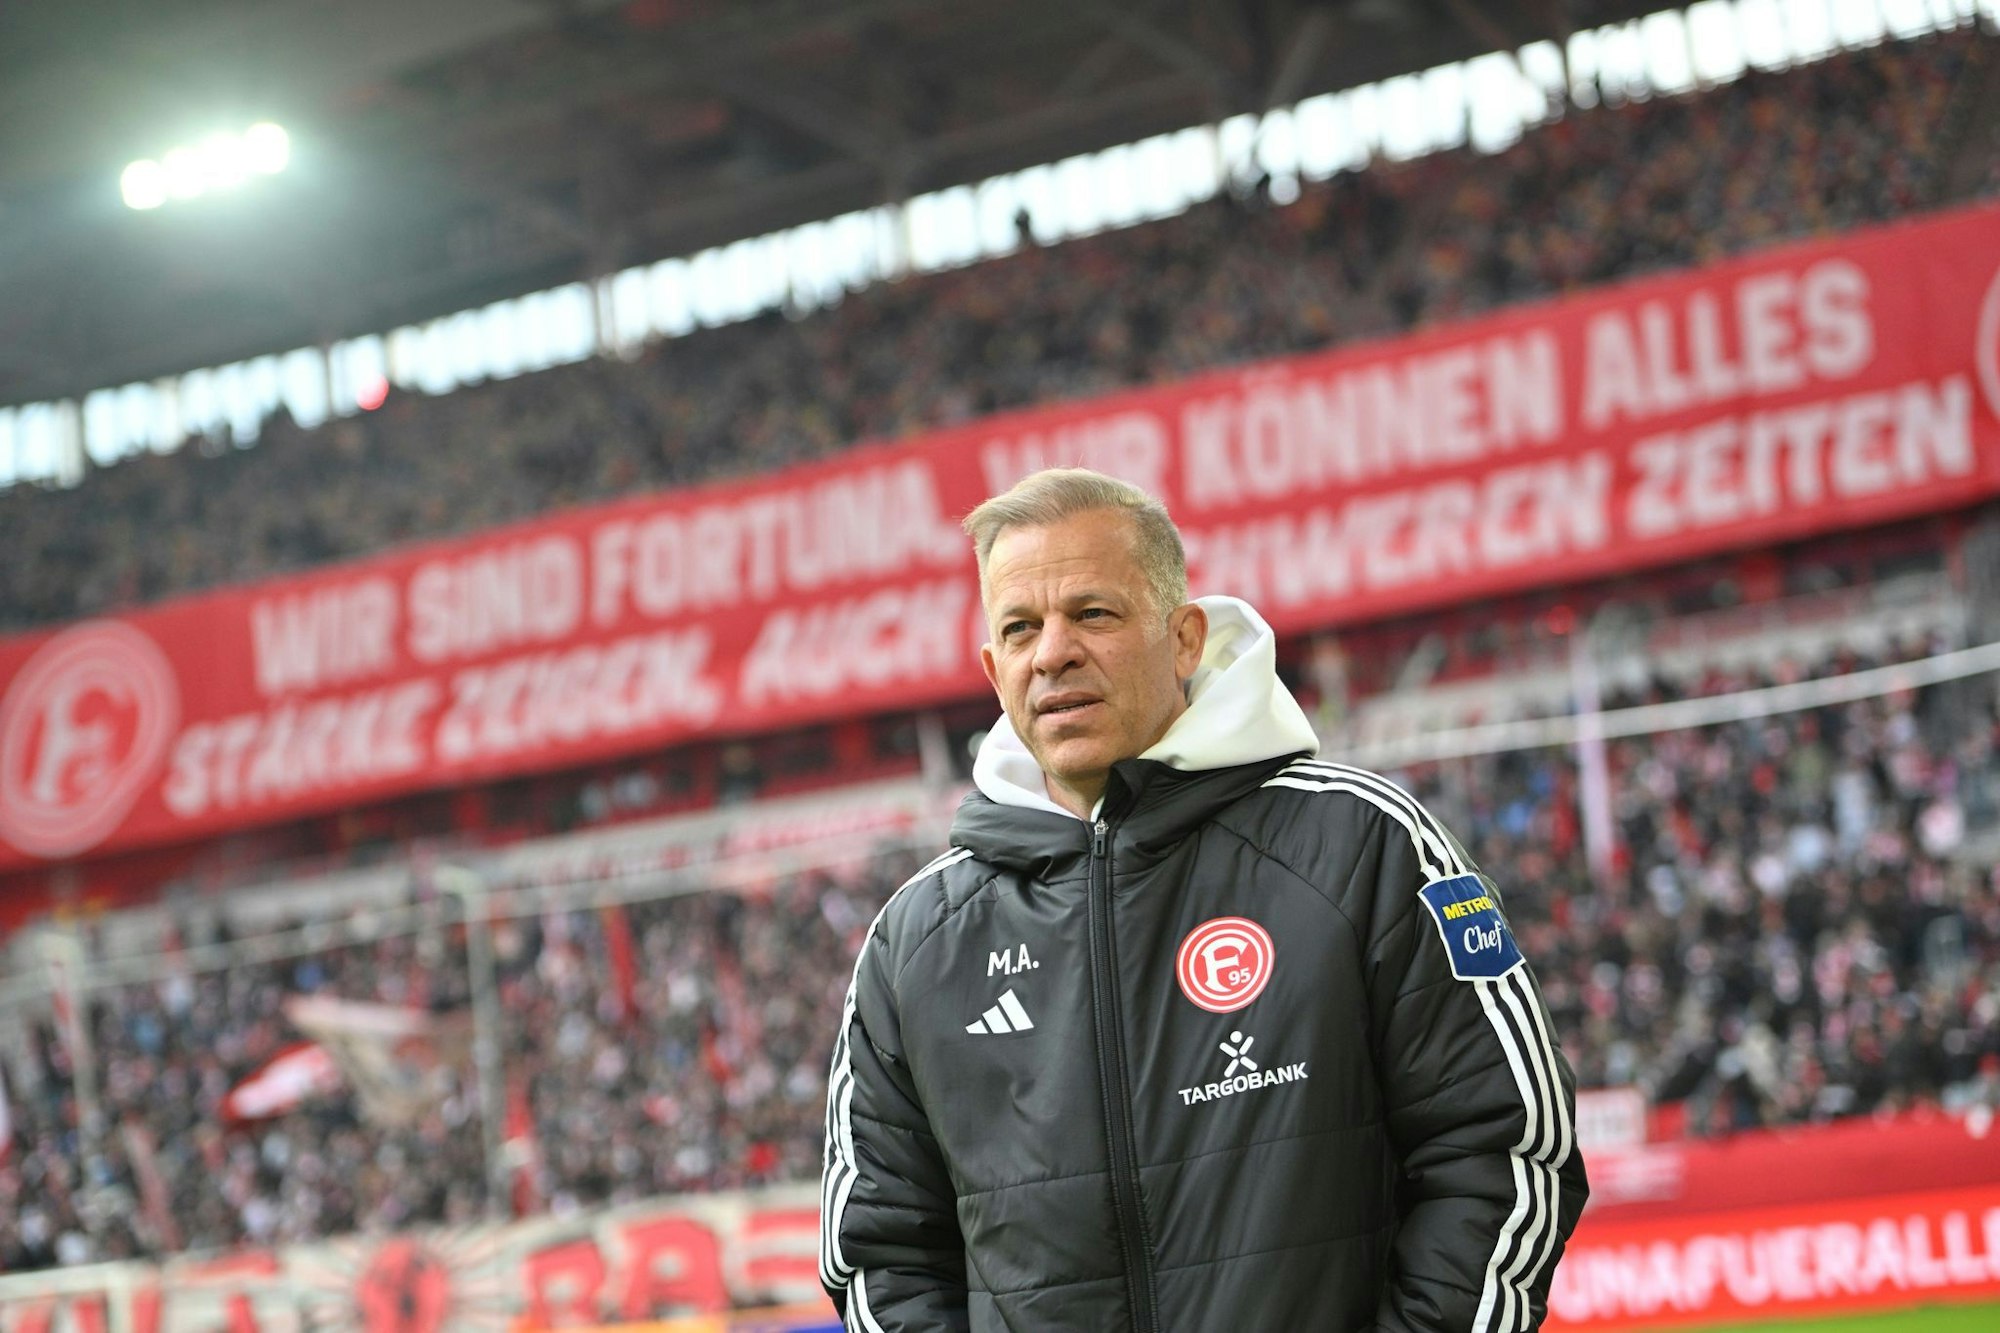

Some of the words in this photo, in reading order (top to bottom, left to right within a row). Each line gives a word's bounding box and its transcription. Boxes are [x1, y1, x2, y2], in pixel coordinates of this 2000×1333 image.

[253, 577, 397, 695] WIR
[409, 535, 580, 662] SIND
[1183, 326, 1560, 508] KÖNNEN
[1584, 260, 1874, 430] ALLES
[739, 579, 972, 701] AUCH
[1627, 375, 1975, 538] ZEITEN
[1442, 896, 1494, 920] METRO
[1463, 920, 1501, 954] Chef
[987, 943, 1039, 976] M.A.
[1228, 967, 1251, 986] 95
[1178, 1062, 1308, 1106] TARGOBANK
